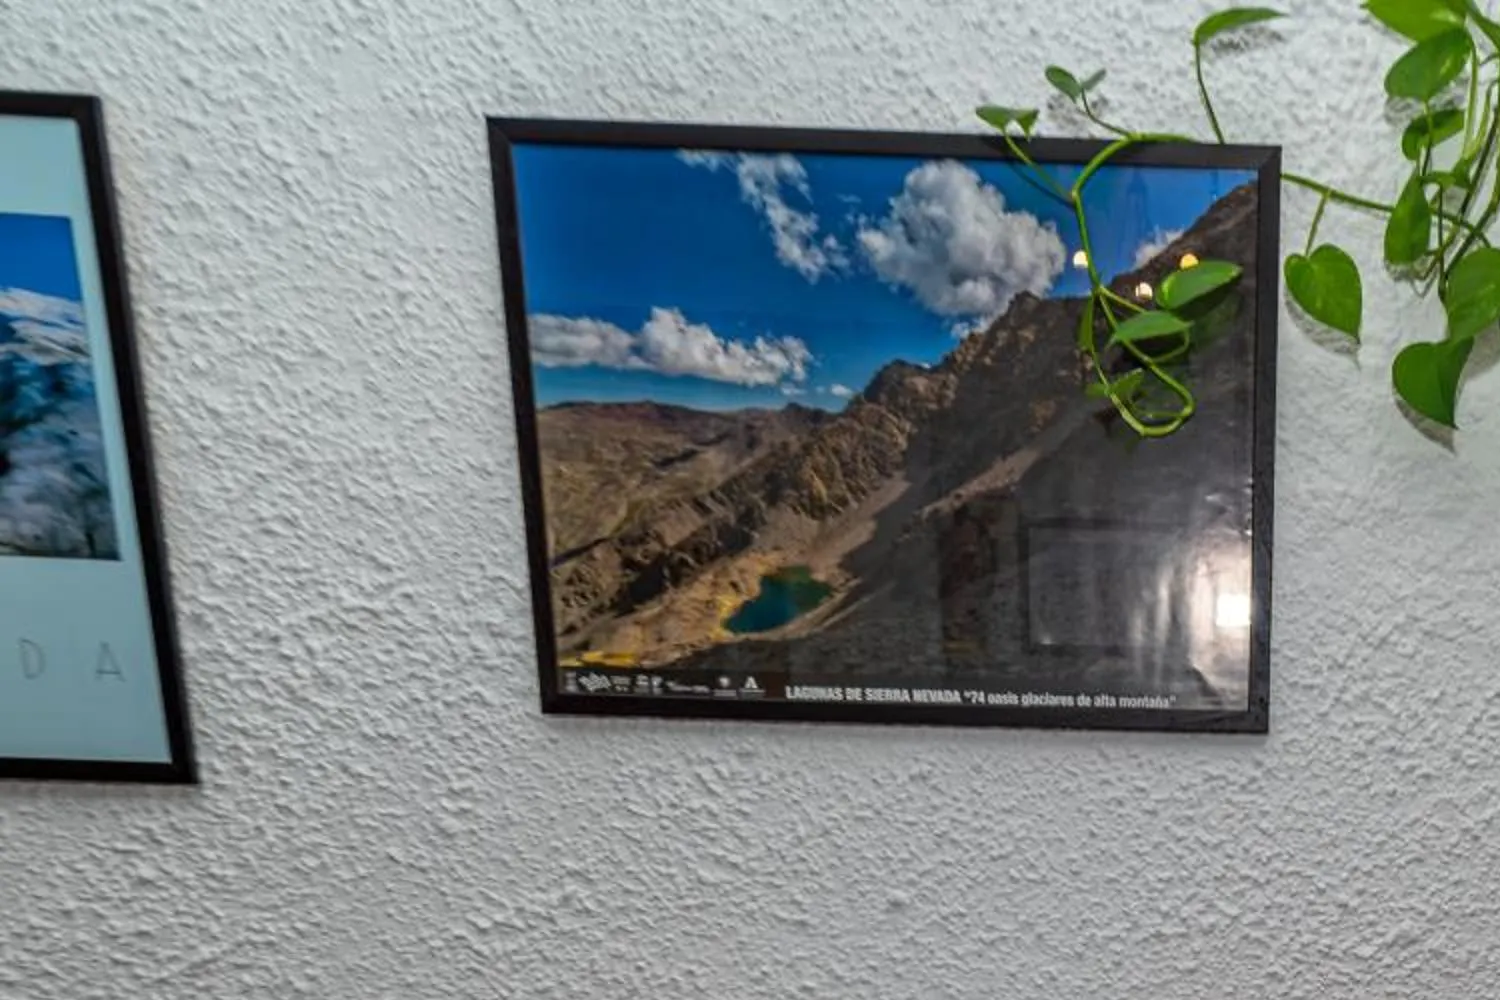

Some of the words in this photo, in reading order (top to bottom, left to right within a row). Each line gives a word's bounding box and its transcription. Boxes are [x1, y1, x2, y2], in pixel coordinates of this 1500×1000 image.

[845, 687, 862, 701] DE
[865, 688, 910, 702] SIERRA
[912, 689, 962, 703] NEVADA
[987, 692, 1019, 705] oasis
[1021, 692, 1075, 707] glaciares
[1076, 693, 1092, 707] de
[1094, 694, 1116, 708] alta
